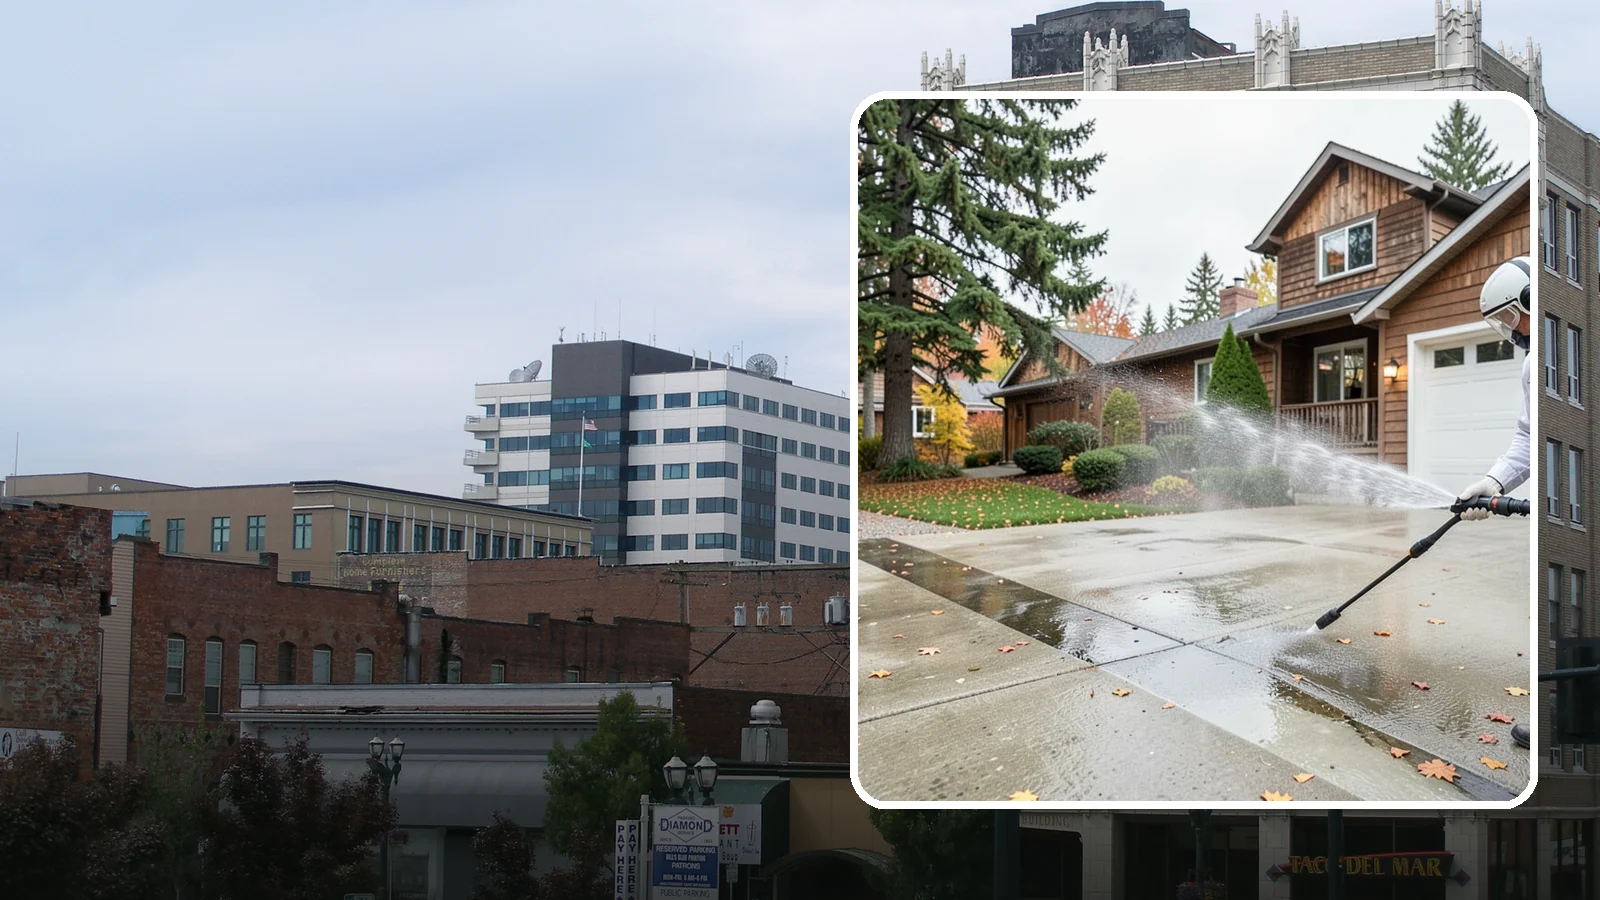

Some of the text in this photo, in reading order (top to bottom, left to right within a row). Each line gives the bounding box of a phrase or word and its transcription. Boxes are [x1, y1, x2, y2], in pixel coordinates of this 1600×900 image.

[343, 566, 427, 577] Home Furnishers
[660, 818, 713, 833] DIAMOND
[1022, 815, 1069, 828] BUILDING
[655, 845, 716, 854] RESERVED PARKING
[616, 825, 625, 893] PAY HERE
[627, 824, 637, 893] PAY HERE
[721, 851, 739, 861] Soup
[671, 861, 701, 870] PATRONS
[1288, 855, 1443, 877] TAC DEL MAR
[660, 888, 710, 898] PUBLIC PARKING
